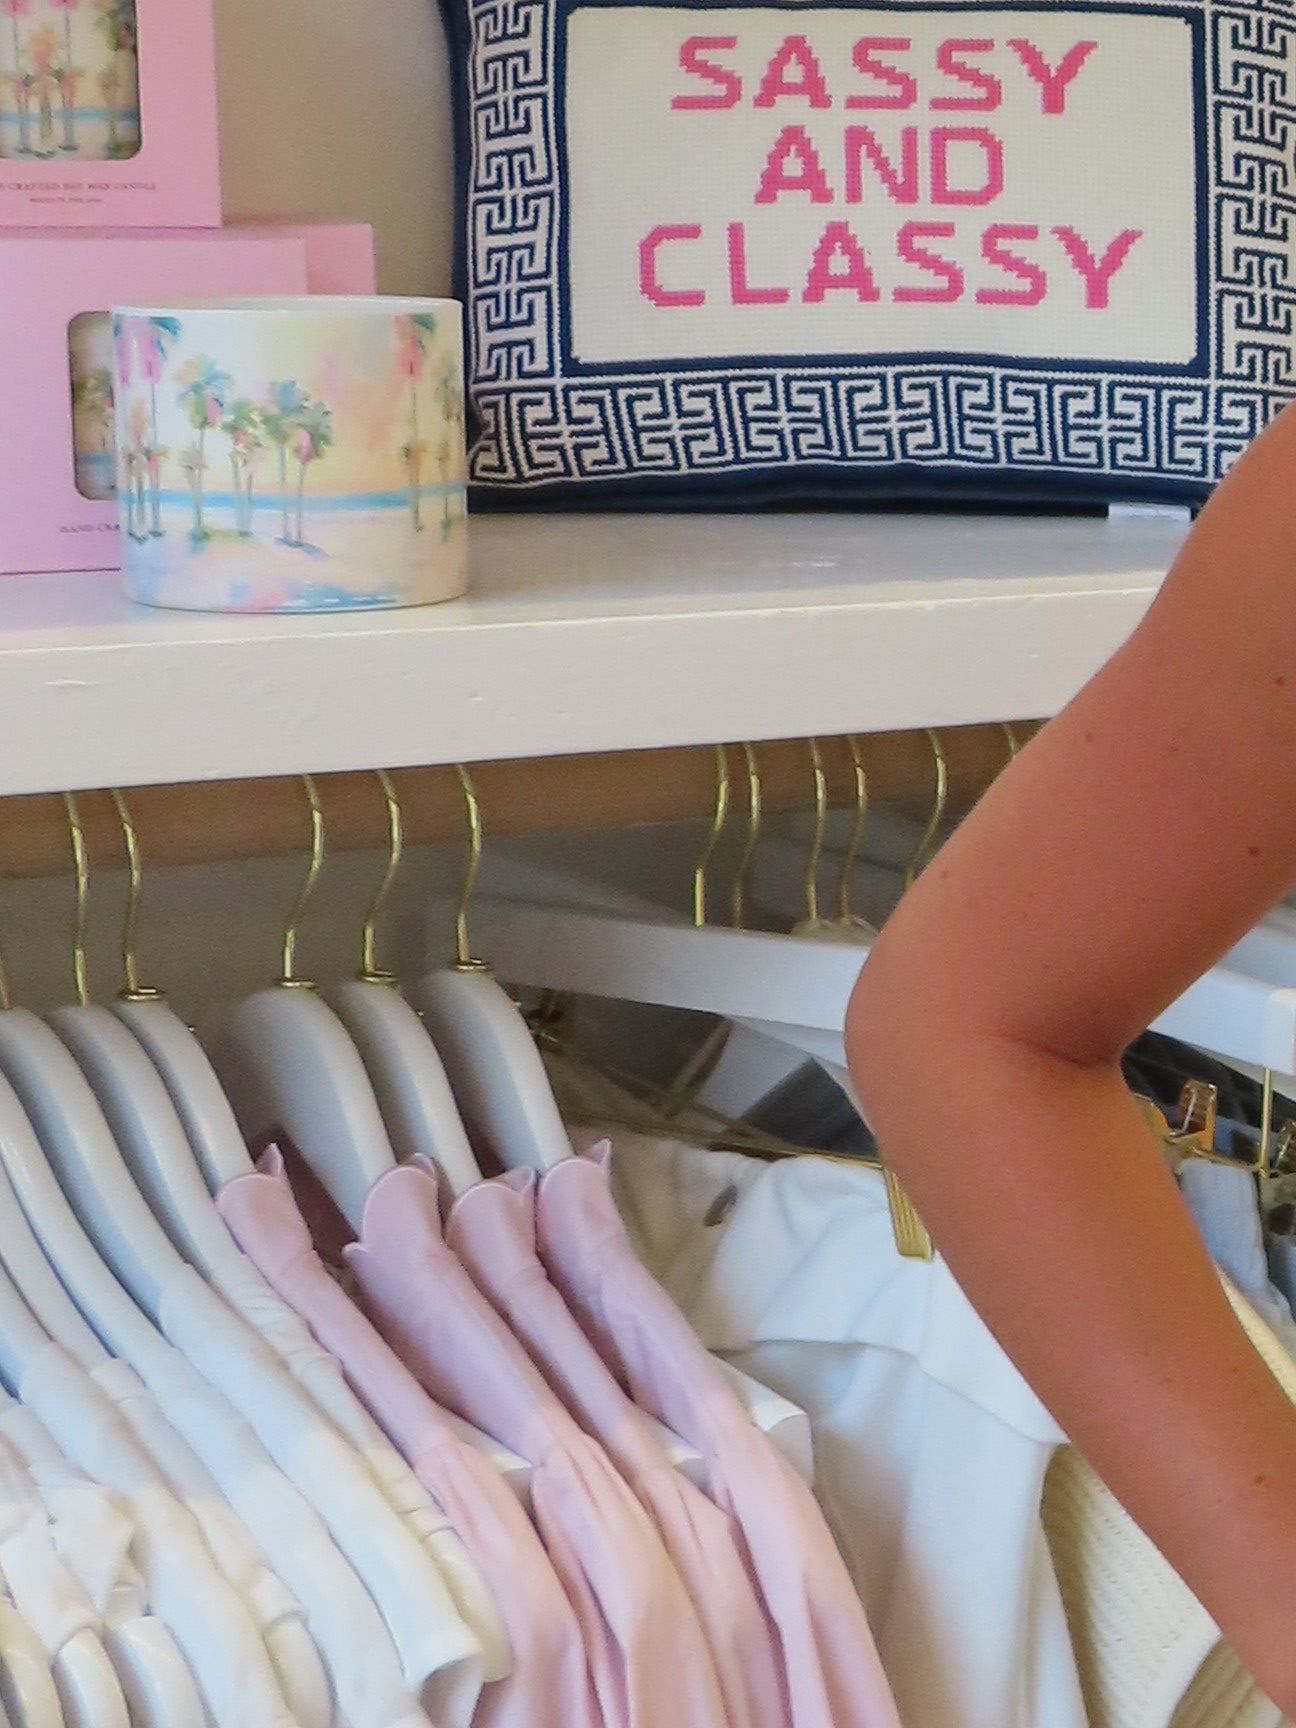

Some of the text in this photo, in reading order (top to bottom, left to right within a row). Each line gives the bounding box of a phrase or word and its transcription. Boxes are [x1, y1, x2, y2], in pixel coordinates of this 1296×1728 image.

[670, 35, 1097, 115] SASSY
[753, 125, 1005, 207] AND
[638, 221, 1142, 310] CLASSY
